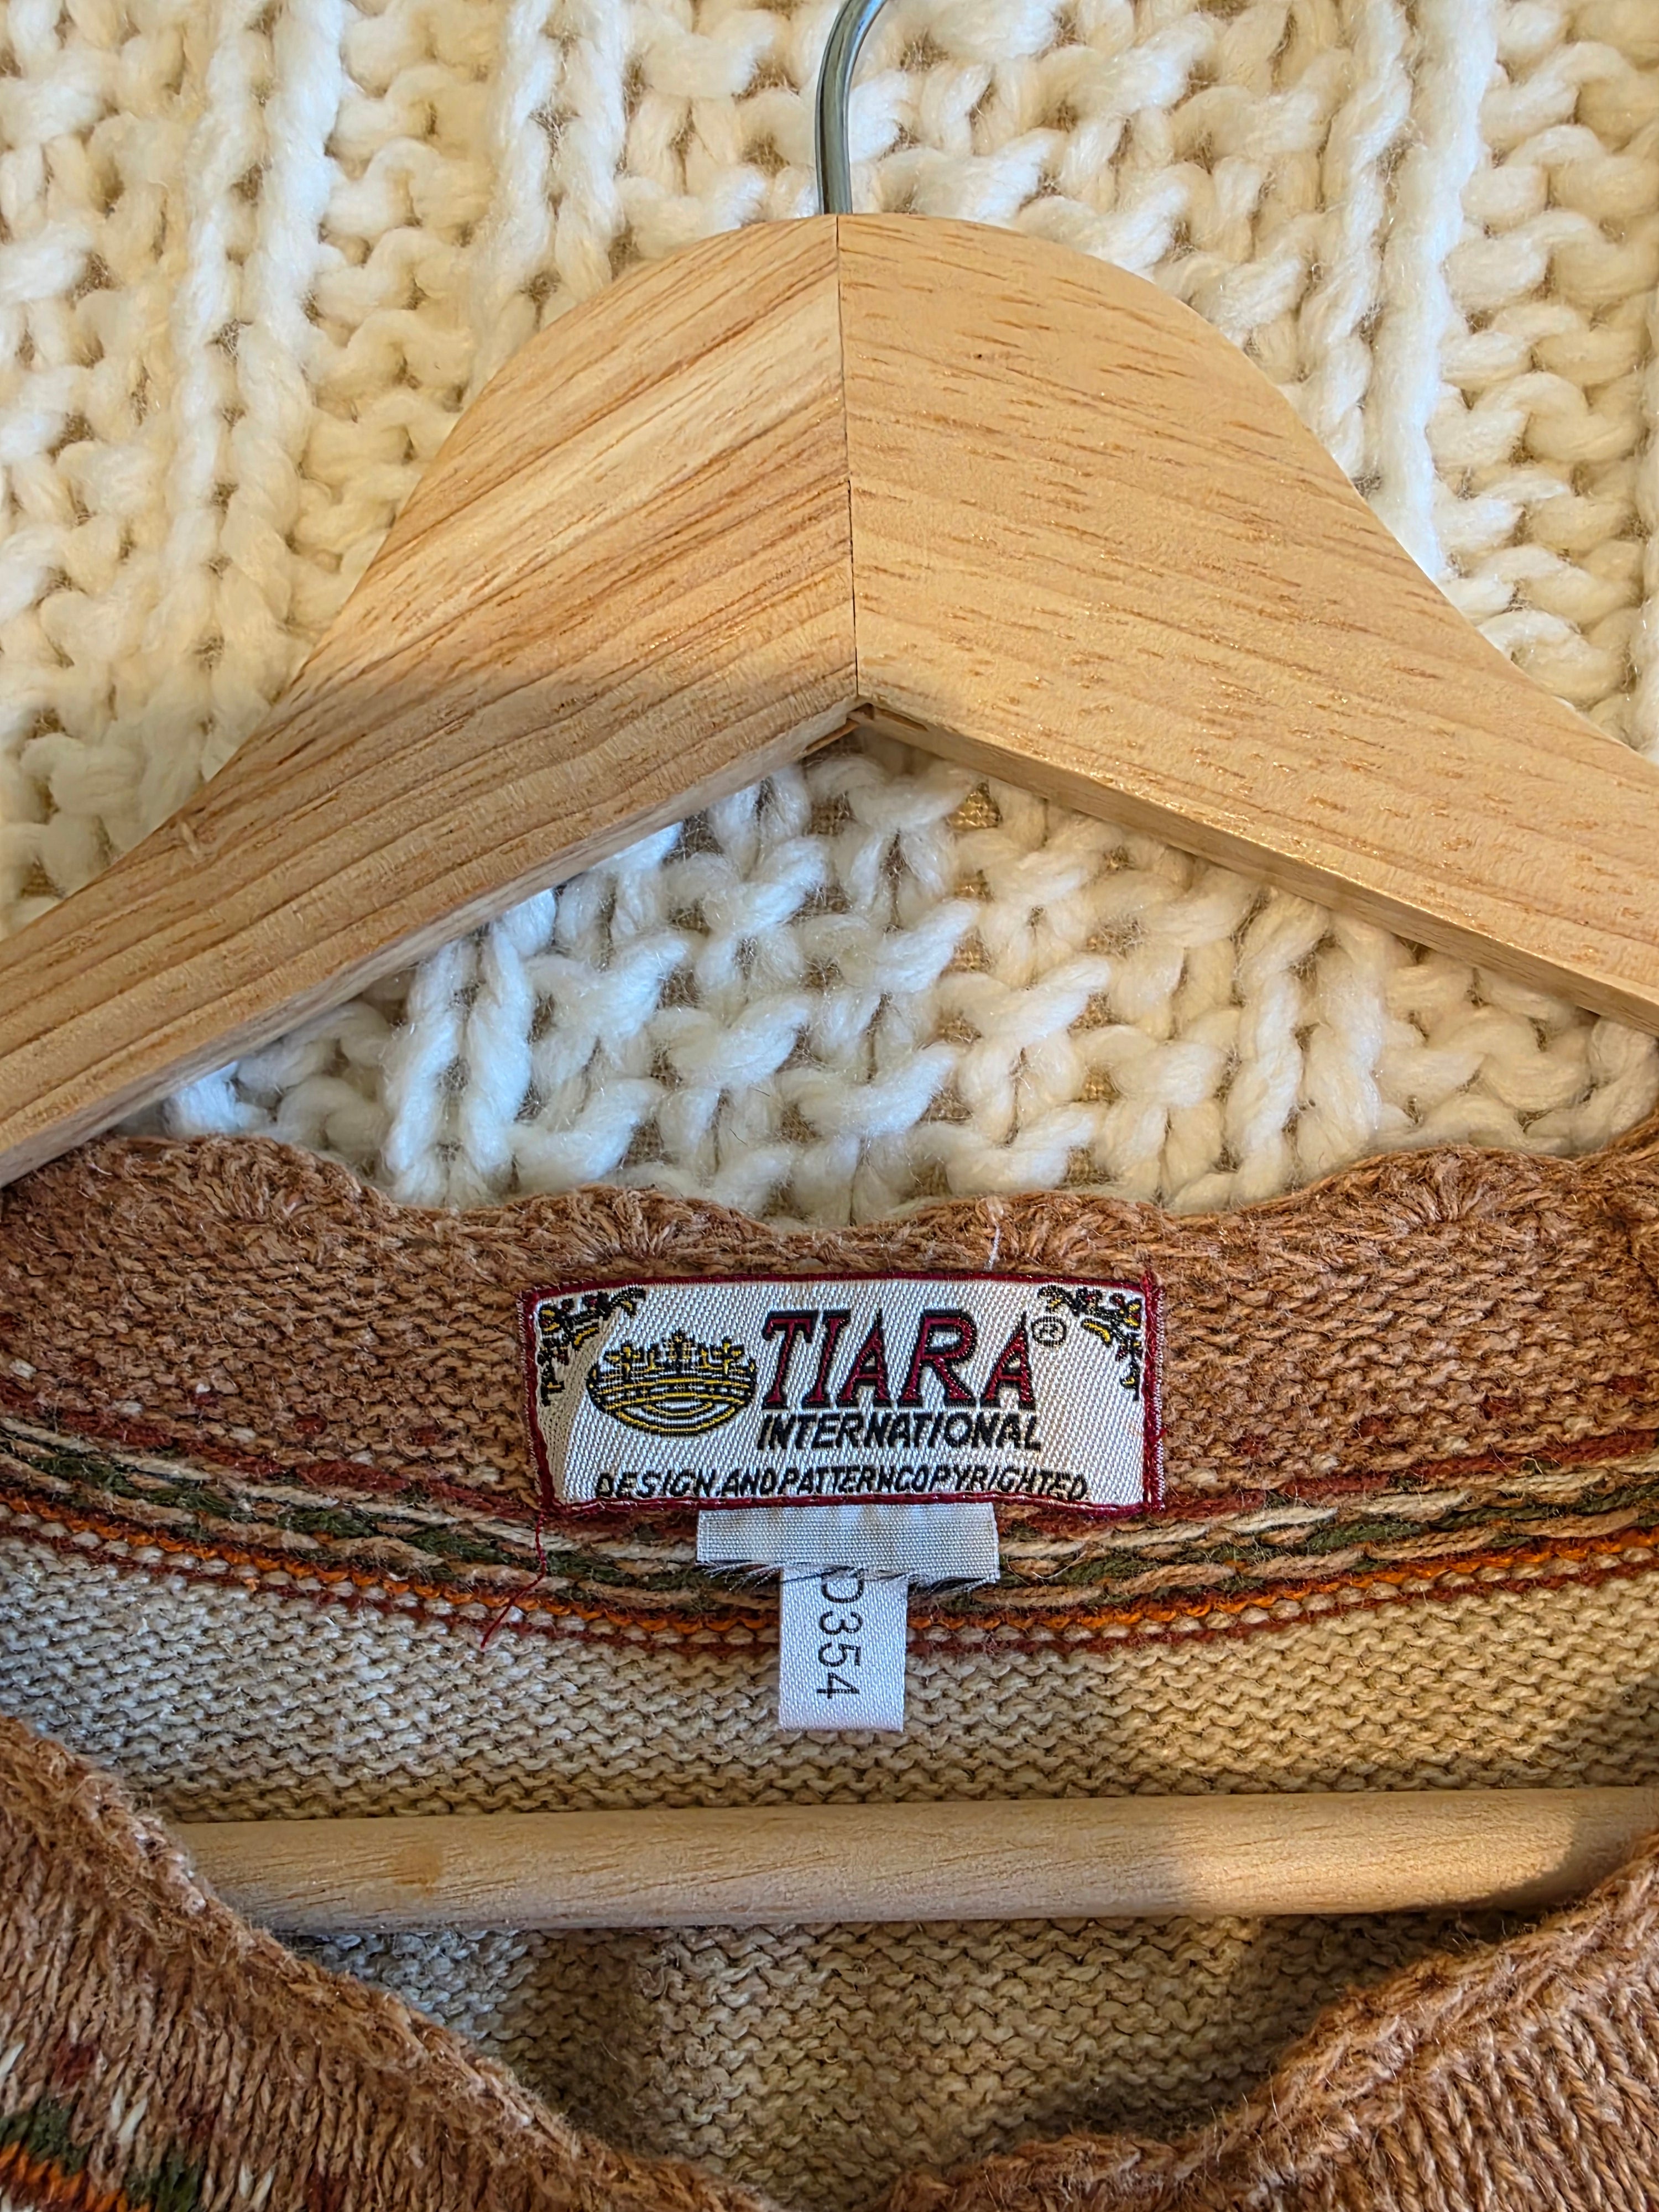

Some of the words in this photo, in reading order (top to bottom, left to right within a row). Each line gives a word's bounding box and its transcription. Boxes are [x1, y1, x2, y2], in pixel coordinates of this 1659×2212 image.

[758, 1412, 1042, 1451] INTERNATIONAL
[596, 1468, 717, 1496] DESIGN
[775, 1465, 896, 1494] PATTERN
[896, 1464, 1088, 1500] COPYRIGHTED
